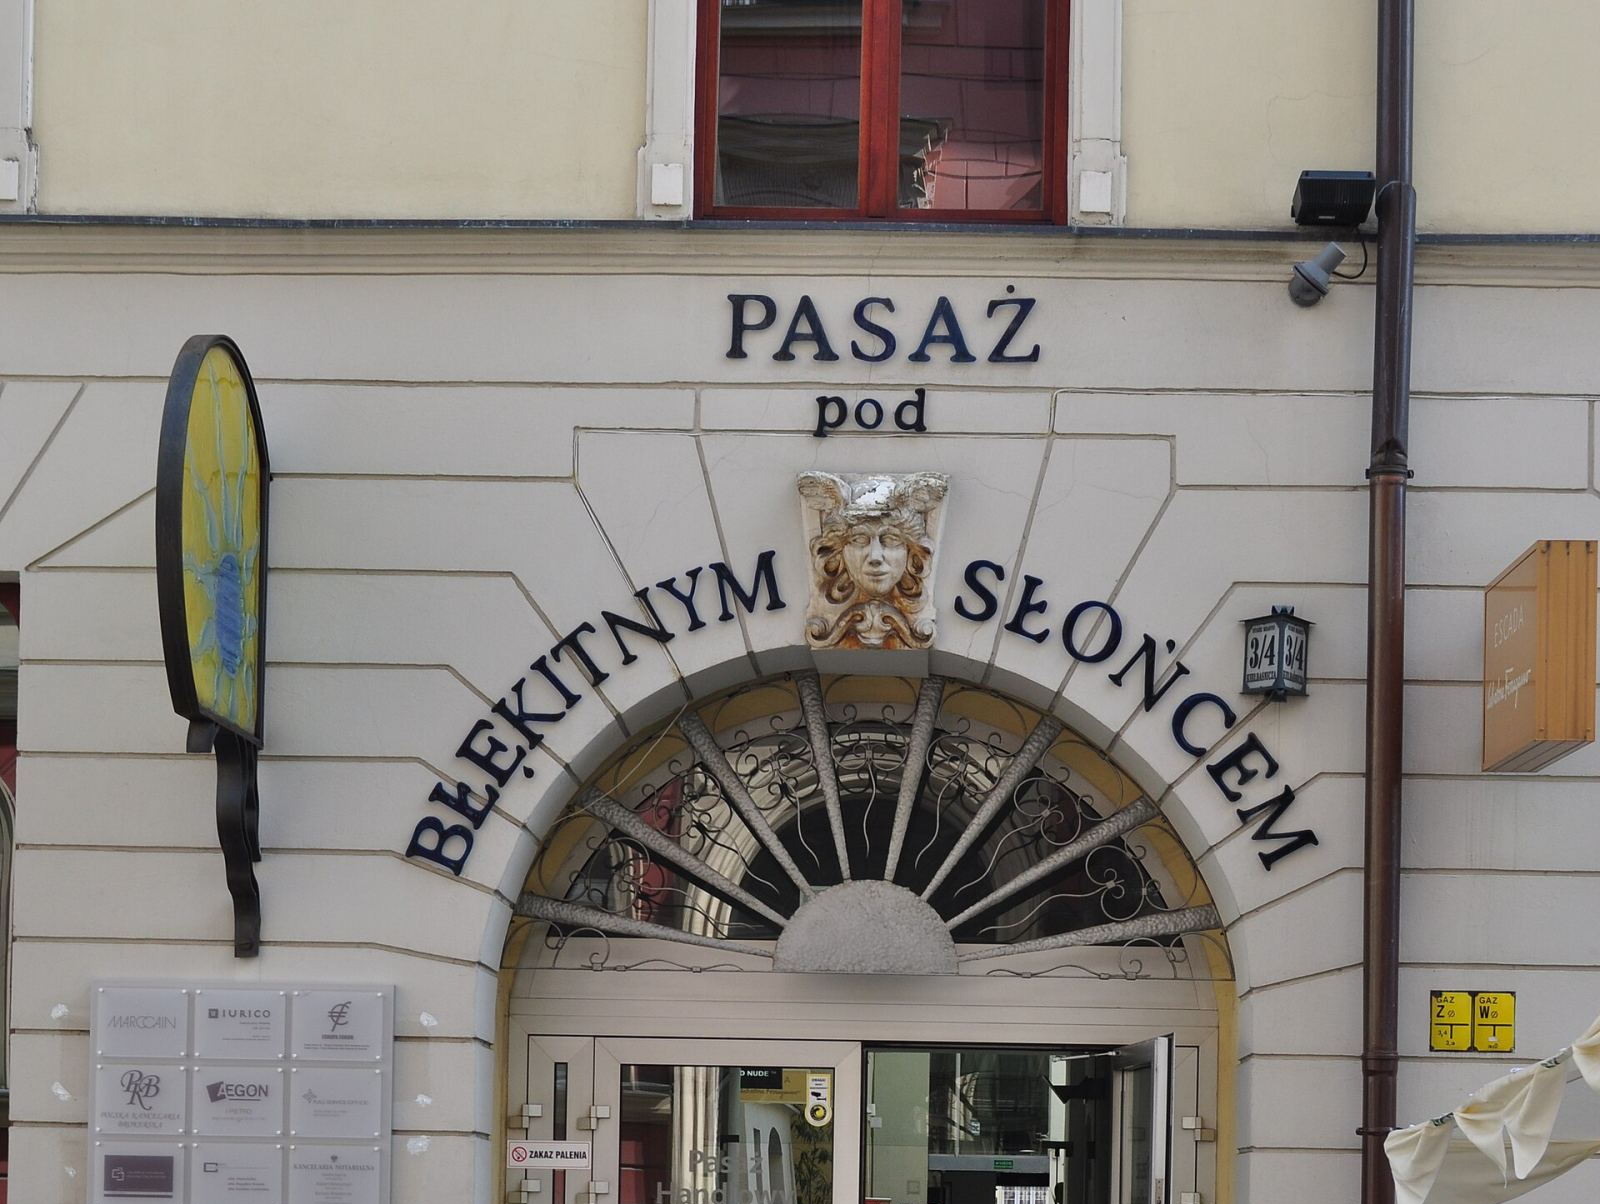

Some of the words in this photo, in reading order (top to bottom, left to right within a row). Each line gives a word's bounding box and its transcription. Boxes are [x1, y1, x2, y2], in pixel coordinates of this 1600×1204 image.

[726, 284, 1041, 363] PASAŻ
[813, 387, 927, 437] pod
[1249, 634, 1276, 669] 3/4
[1285, 635, 1304, 671] 3/4
[405, 550, 787, 876] BŁĘKITNYM
[954, 560, 1319, 871] SŁOŃCEM
[1479, 996, 1498, 1004] GAZ
[1479, 1006, 1490, 1019] W
[217, 1082, 268, 1097] AEGON
[529, 1150, 553, 1159] ZAKAZ
[555, 1151, 587, 1160] PALENIA
